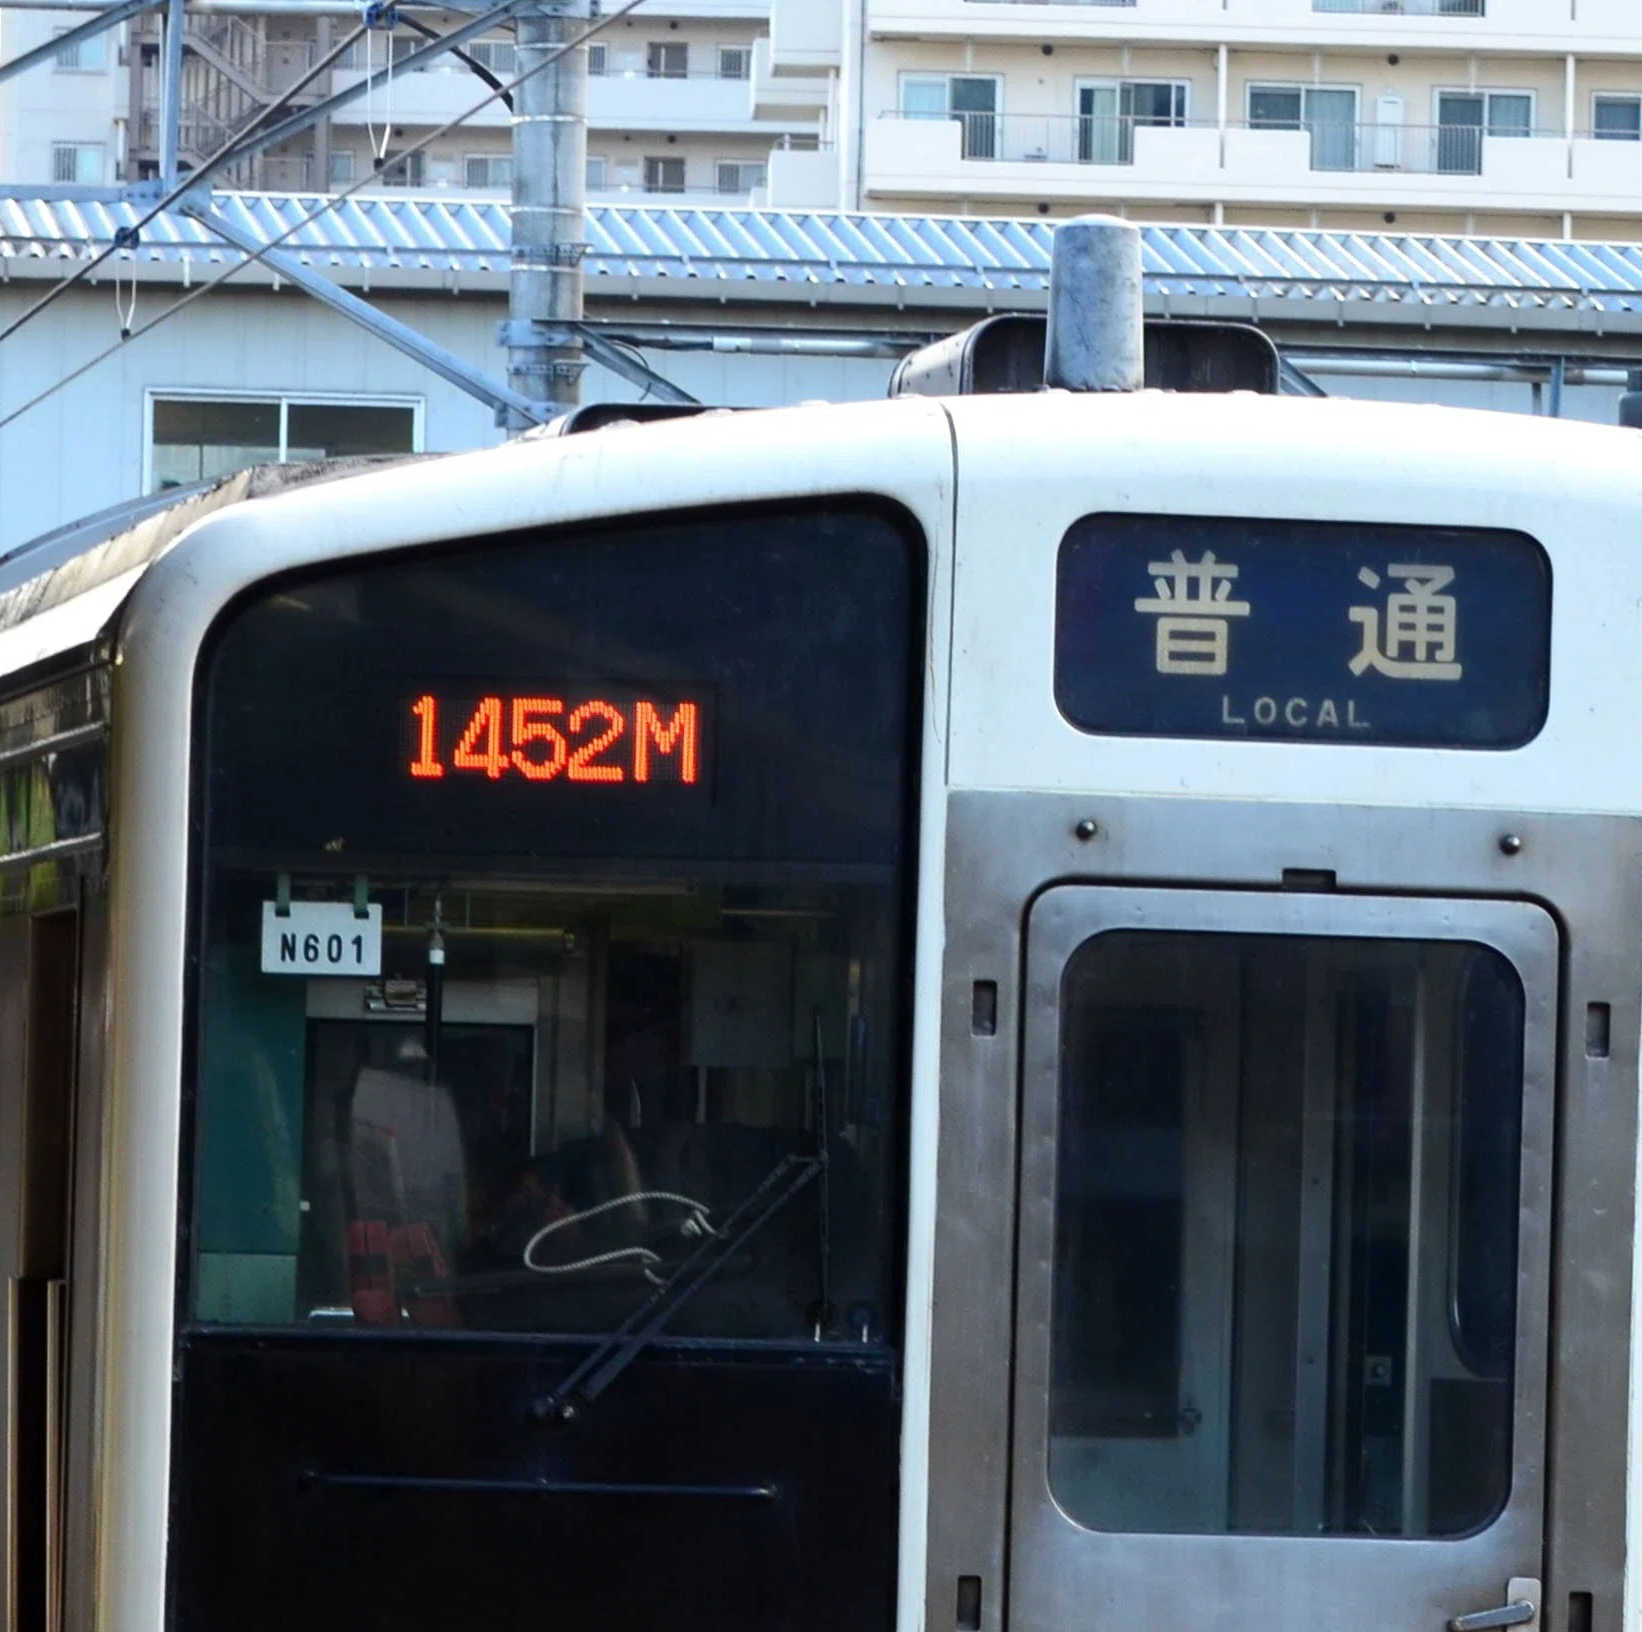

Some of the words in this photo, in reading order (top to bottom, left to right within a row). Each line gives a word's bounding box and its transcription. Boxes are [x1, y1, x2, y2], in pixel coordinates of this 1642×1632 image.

[1134, 549, 1463, 681] 普通
[410, 695, 698, 783] 1452M
[1221, 695, 1371, 729] LOCAL
[279, 932, 366, 964] N601
